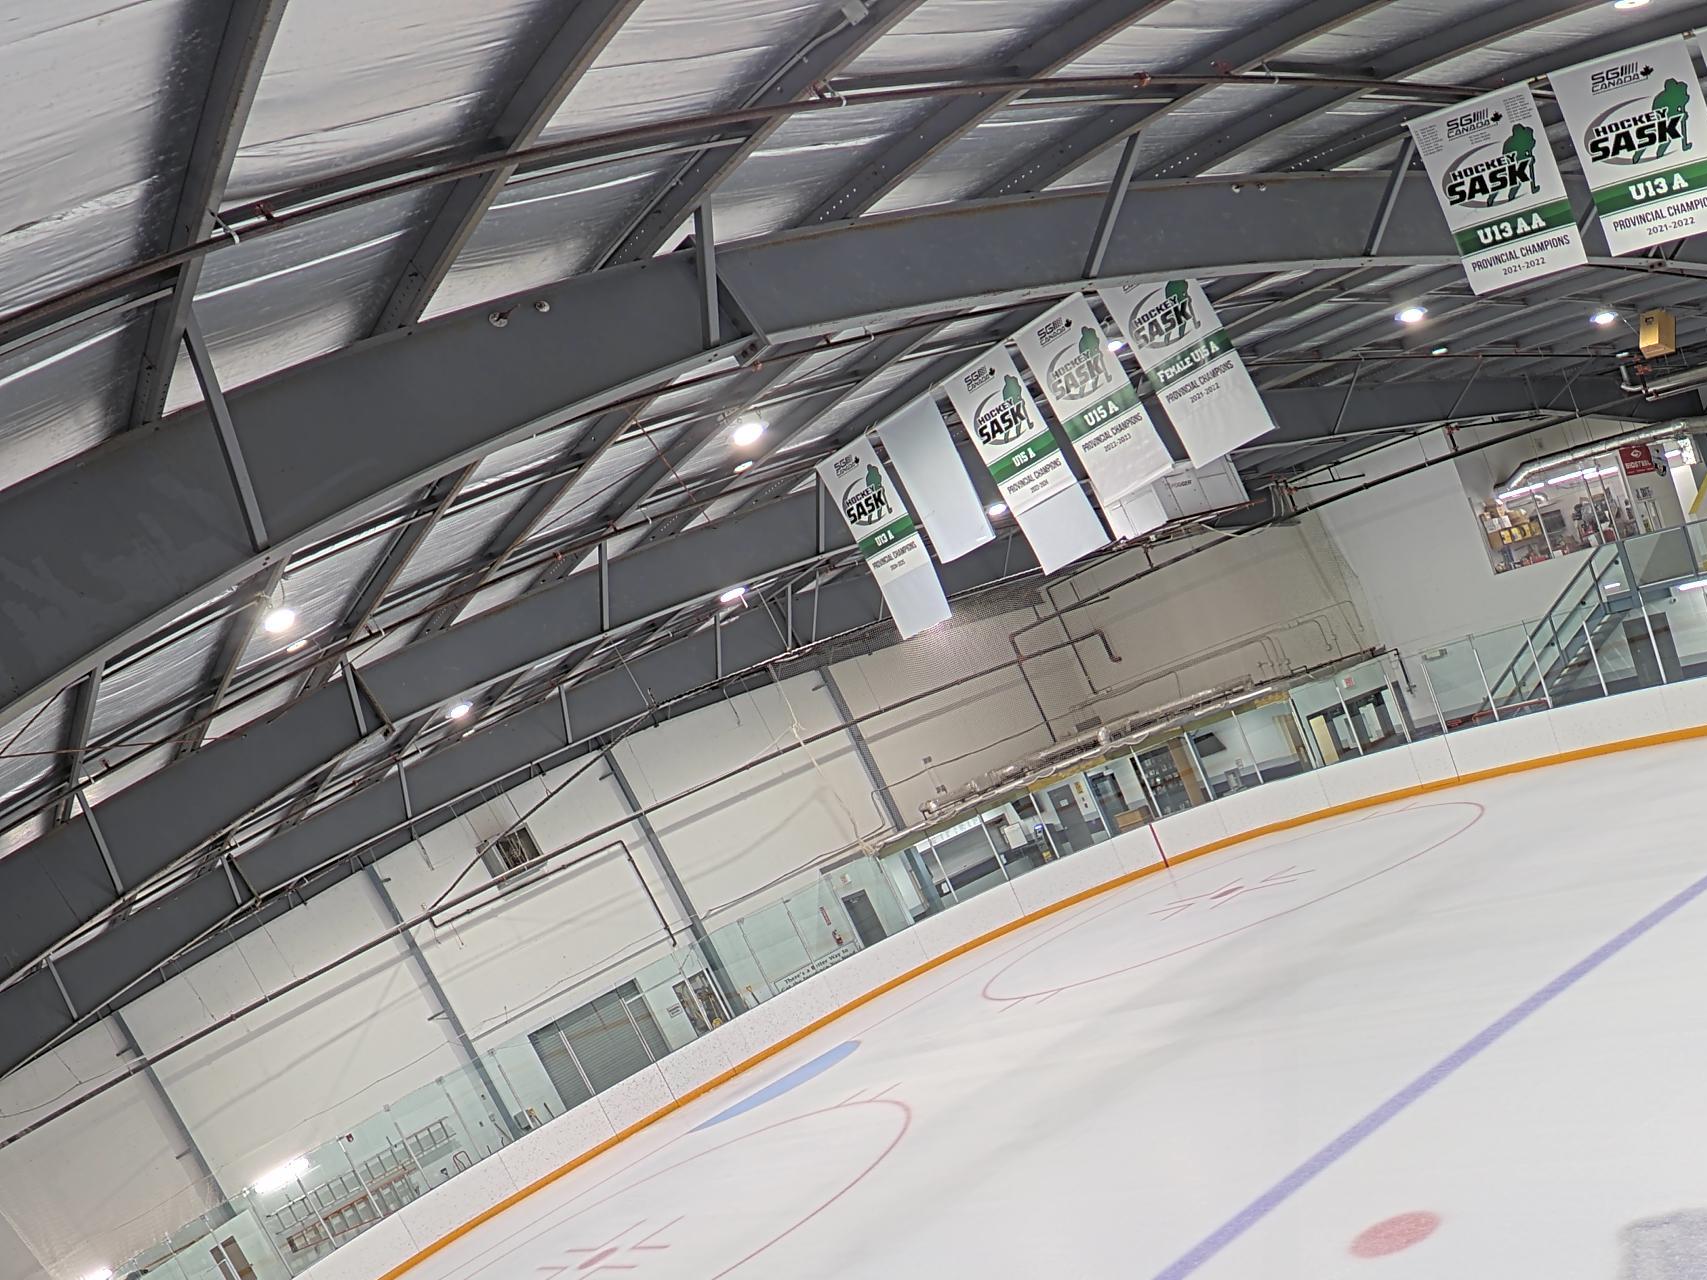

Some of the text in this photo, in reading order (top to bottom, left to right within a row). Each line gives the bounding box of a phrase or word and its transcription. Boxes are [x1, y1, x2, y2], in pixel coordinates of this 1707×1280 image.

[1592, 72, 1640, 93] CANADA
[1447, 120, 1491, 139] CANADA
[1594, 106, 1669, 137] HOCKEY
[1589, 114, 1683, 163] SASK
[1452, 152, 1517, 181] HOCKEY
[1447, 159, 1531, 205] SASK
[1628, 173, 1688, 200] U13 A
[1477, 212, 1546, 244] U13 AA
[1613, 209, 1667, 231] PROVINCIAL
[1646, 216, 1696, 236] 2021-2022
[1471, 234, 1570, 272] PROVINCIAL CHAMPIONS
[1502, 257, 1546, 275] 2021-2022
[1134, 295, 1177, 327] HOCKEY
[1134, 300, 1192, 350] SASK
[1052, 350, 1091, 380] HOCKEY
[1157, 341, 1220, 382] FEMALE U15 A
[1051, 355, 1103, 400] SASK
[1165, 360, 1234, 403] PROVINCIAL CHAMPIONS
[978, 399, 1013, 425] HOCKEY
[978, 403, 1026, 445] SASK
[1084, 401, 1119, 426] U15 A
[1112, 413, 1143, 436] CHAMPIONS
[1012, 447, 1036, 467] U15 A
[846, 485, 875, 506] HOCKEY
[846, 490, 886, 525] SASK
[874, 535, 888, 547] U13
